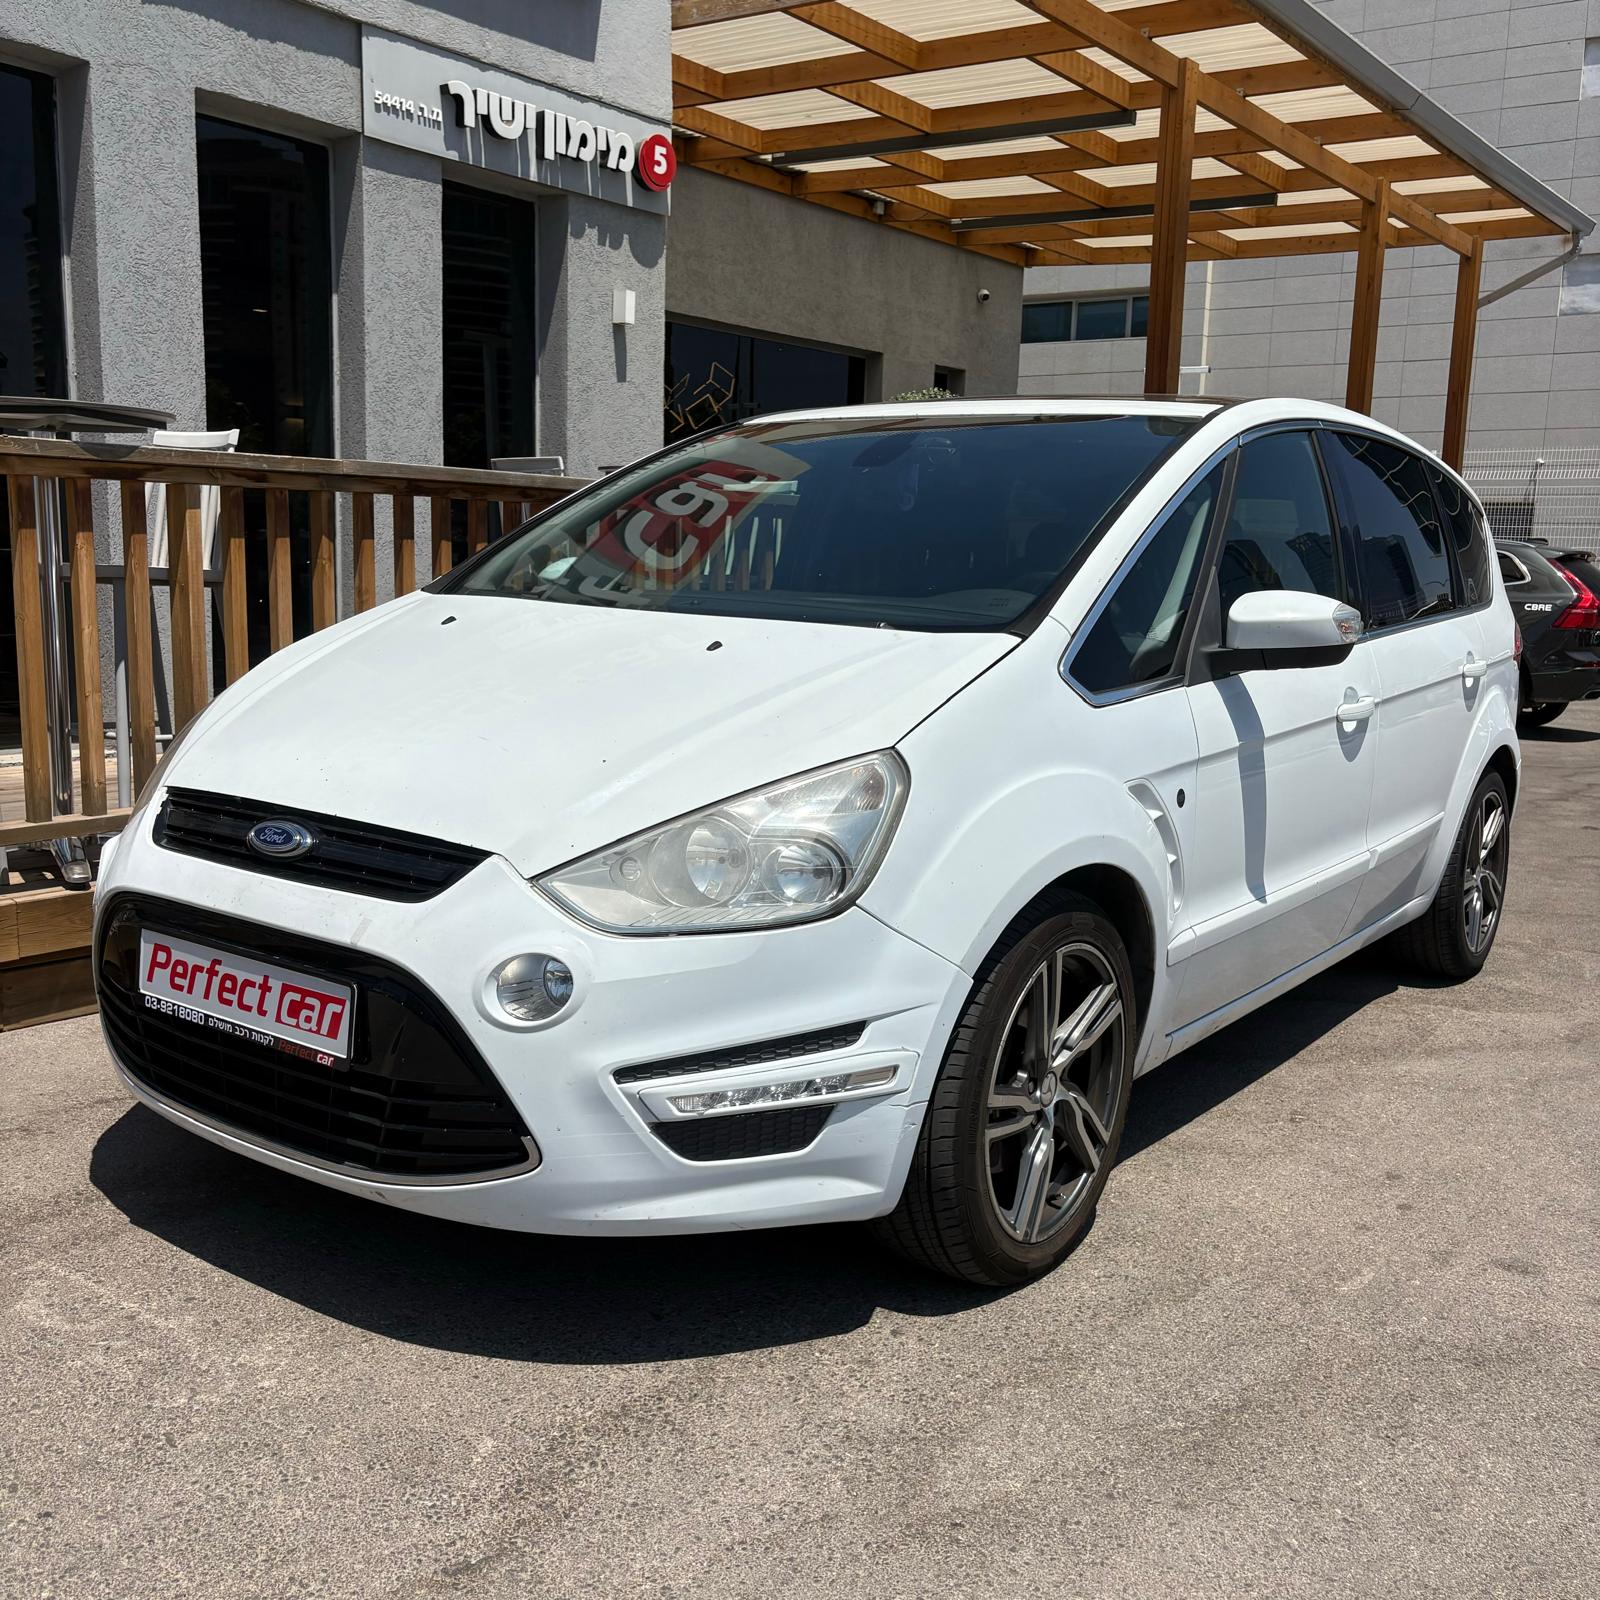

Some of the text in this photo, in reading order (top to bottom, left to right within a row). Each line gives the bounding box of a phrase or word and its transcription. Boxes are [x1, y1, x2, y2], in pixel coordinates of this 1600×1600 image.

[374, 90, 415, 114] 54414
[446, 79, 668, 175] 5 מימון ישיר
[1524, 603, 1553, 612] CBRE
[260, 827, 287, 844] Ford
[146, 942, 343, 1037] Perfect car
[144, 995, 205, 1025] 03-9218080
[208, 1017, 233, 1033] מושלם
[234, 1025, 249, 1039] רכב
[251, 1031, 275, 1046] לקנות
[316, 1053, 334, 1067] car
